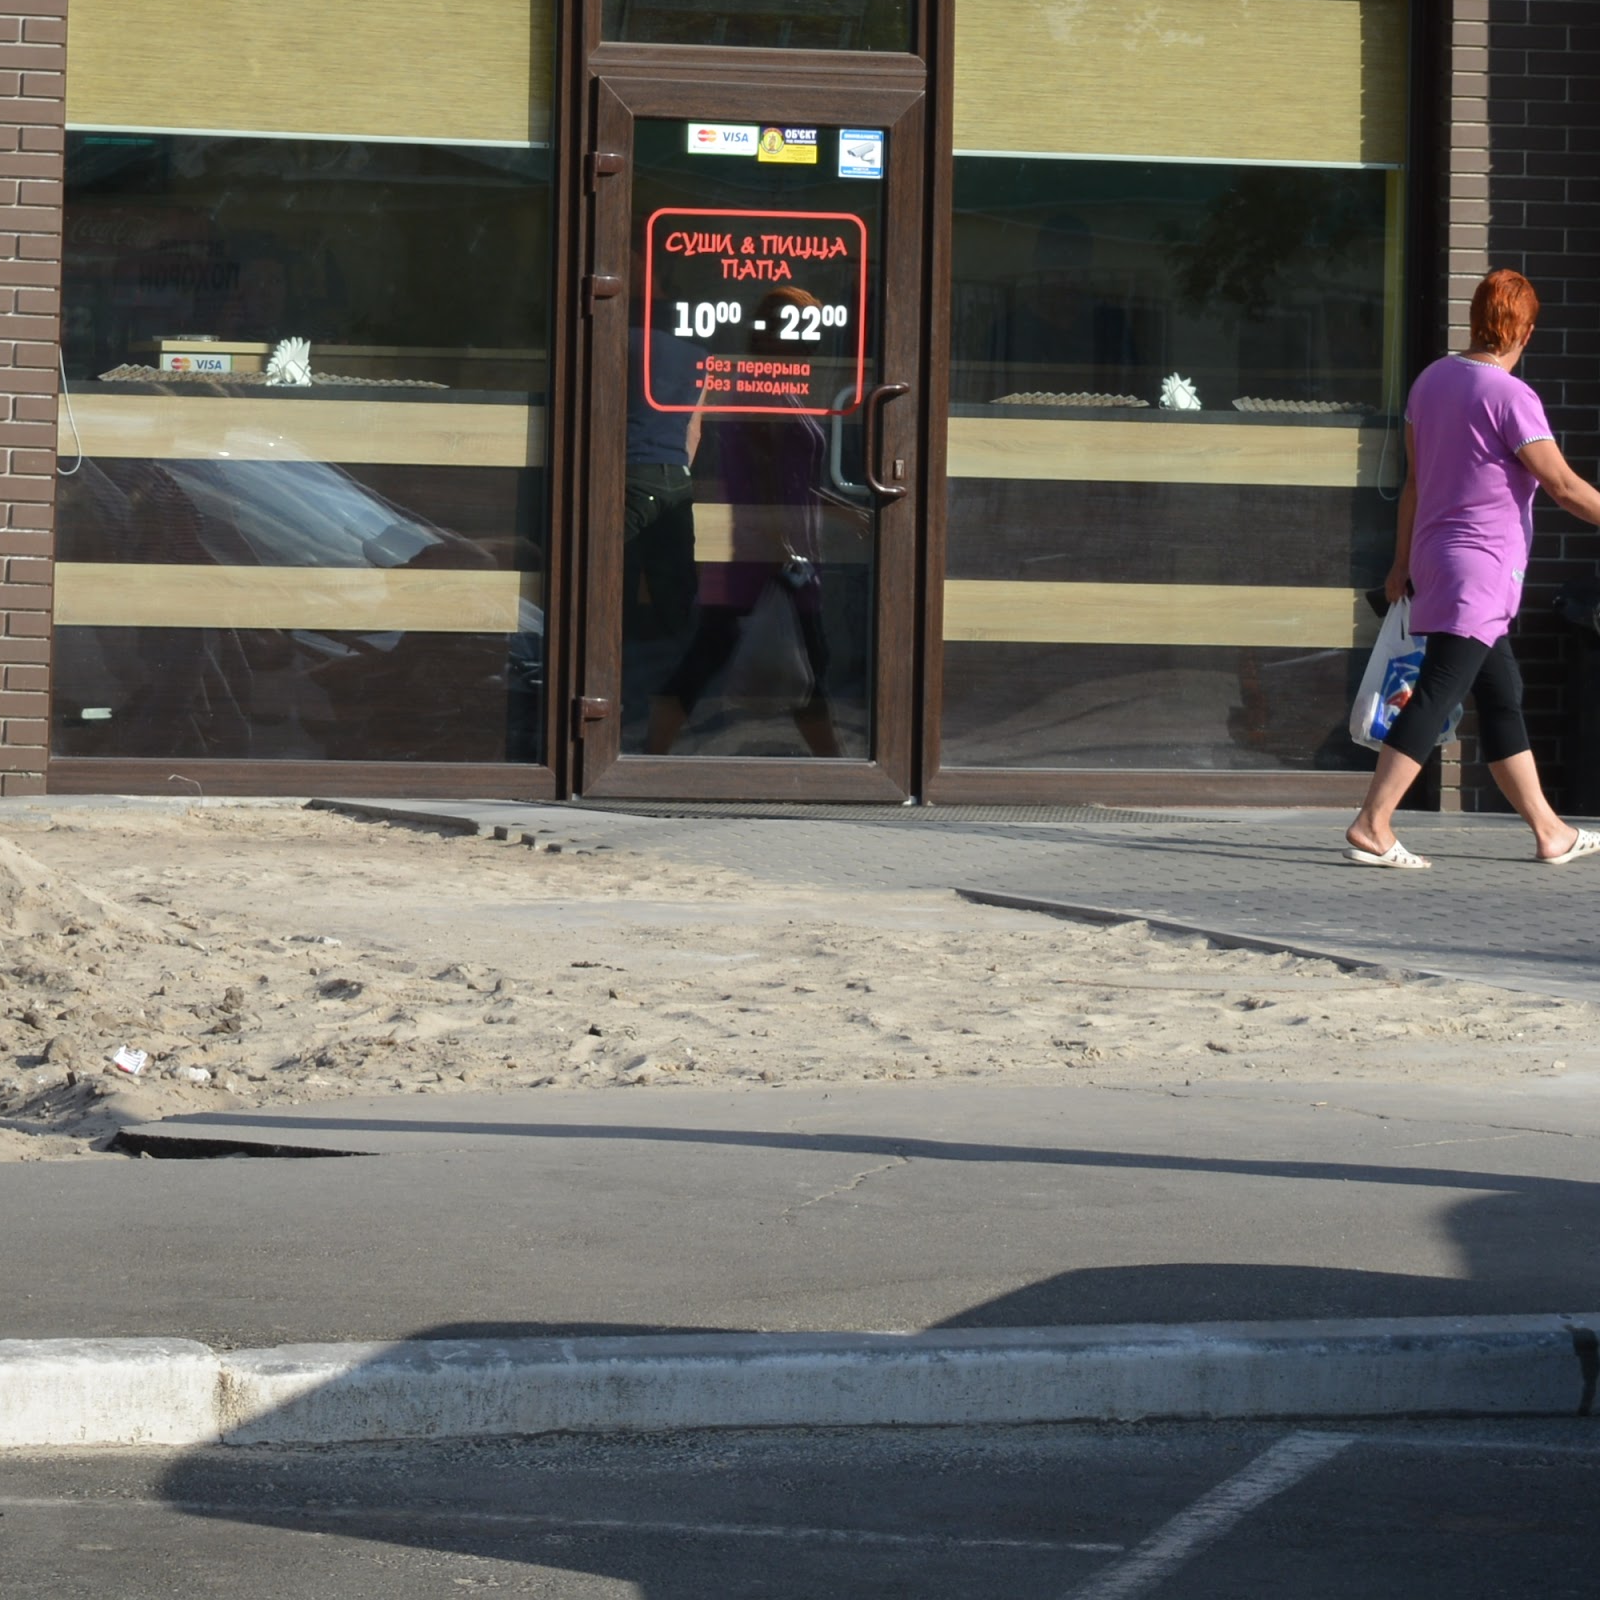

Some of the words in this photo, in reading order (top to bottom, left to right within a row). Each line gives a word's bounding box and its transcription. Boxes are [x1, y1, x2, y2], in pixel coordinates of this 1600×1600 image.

[722, 131, 749, 143] VISA
[665, 231, 735, 257] СУШИ
[740, 235, 756, 255] &
[760, 234, 848, 261] ПИЦЦА
[720, 258, 793, 282] ПАПА
[195, 359, 223, 370] VISA
[705, 355, 732, 373] без
[736, 360, 811, 379] перерыва
[705, 375, 731, 392] без
[736, 380, 810, 396] выходных
